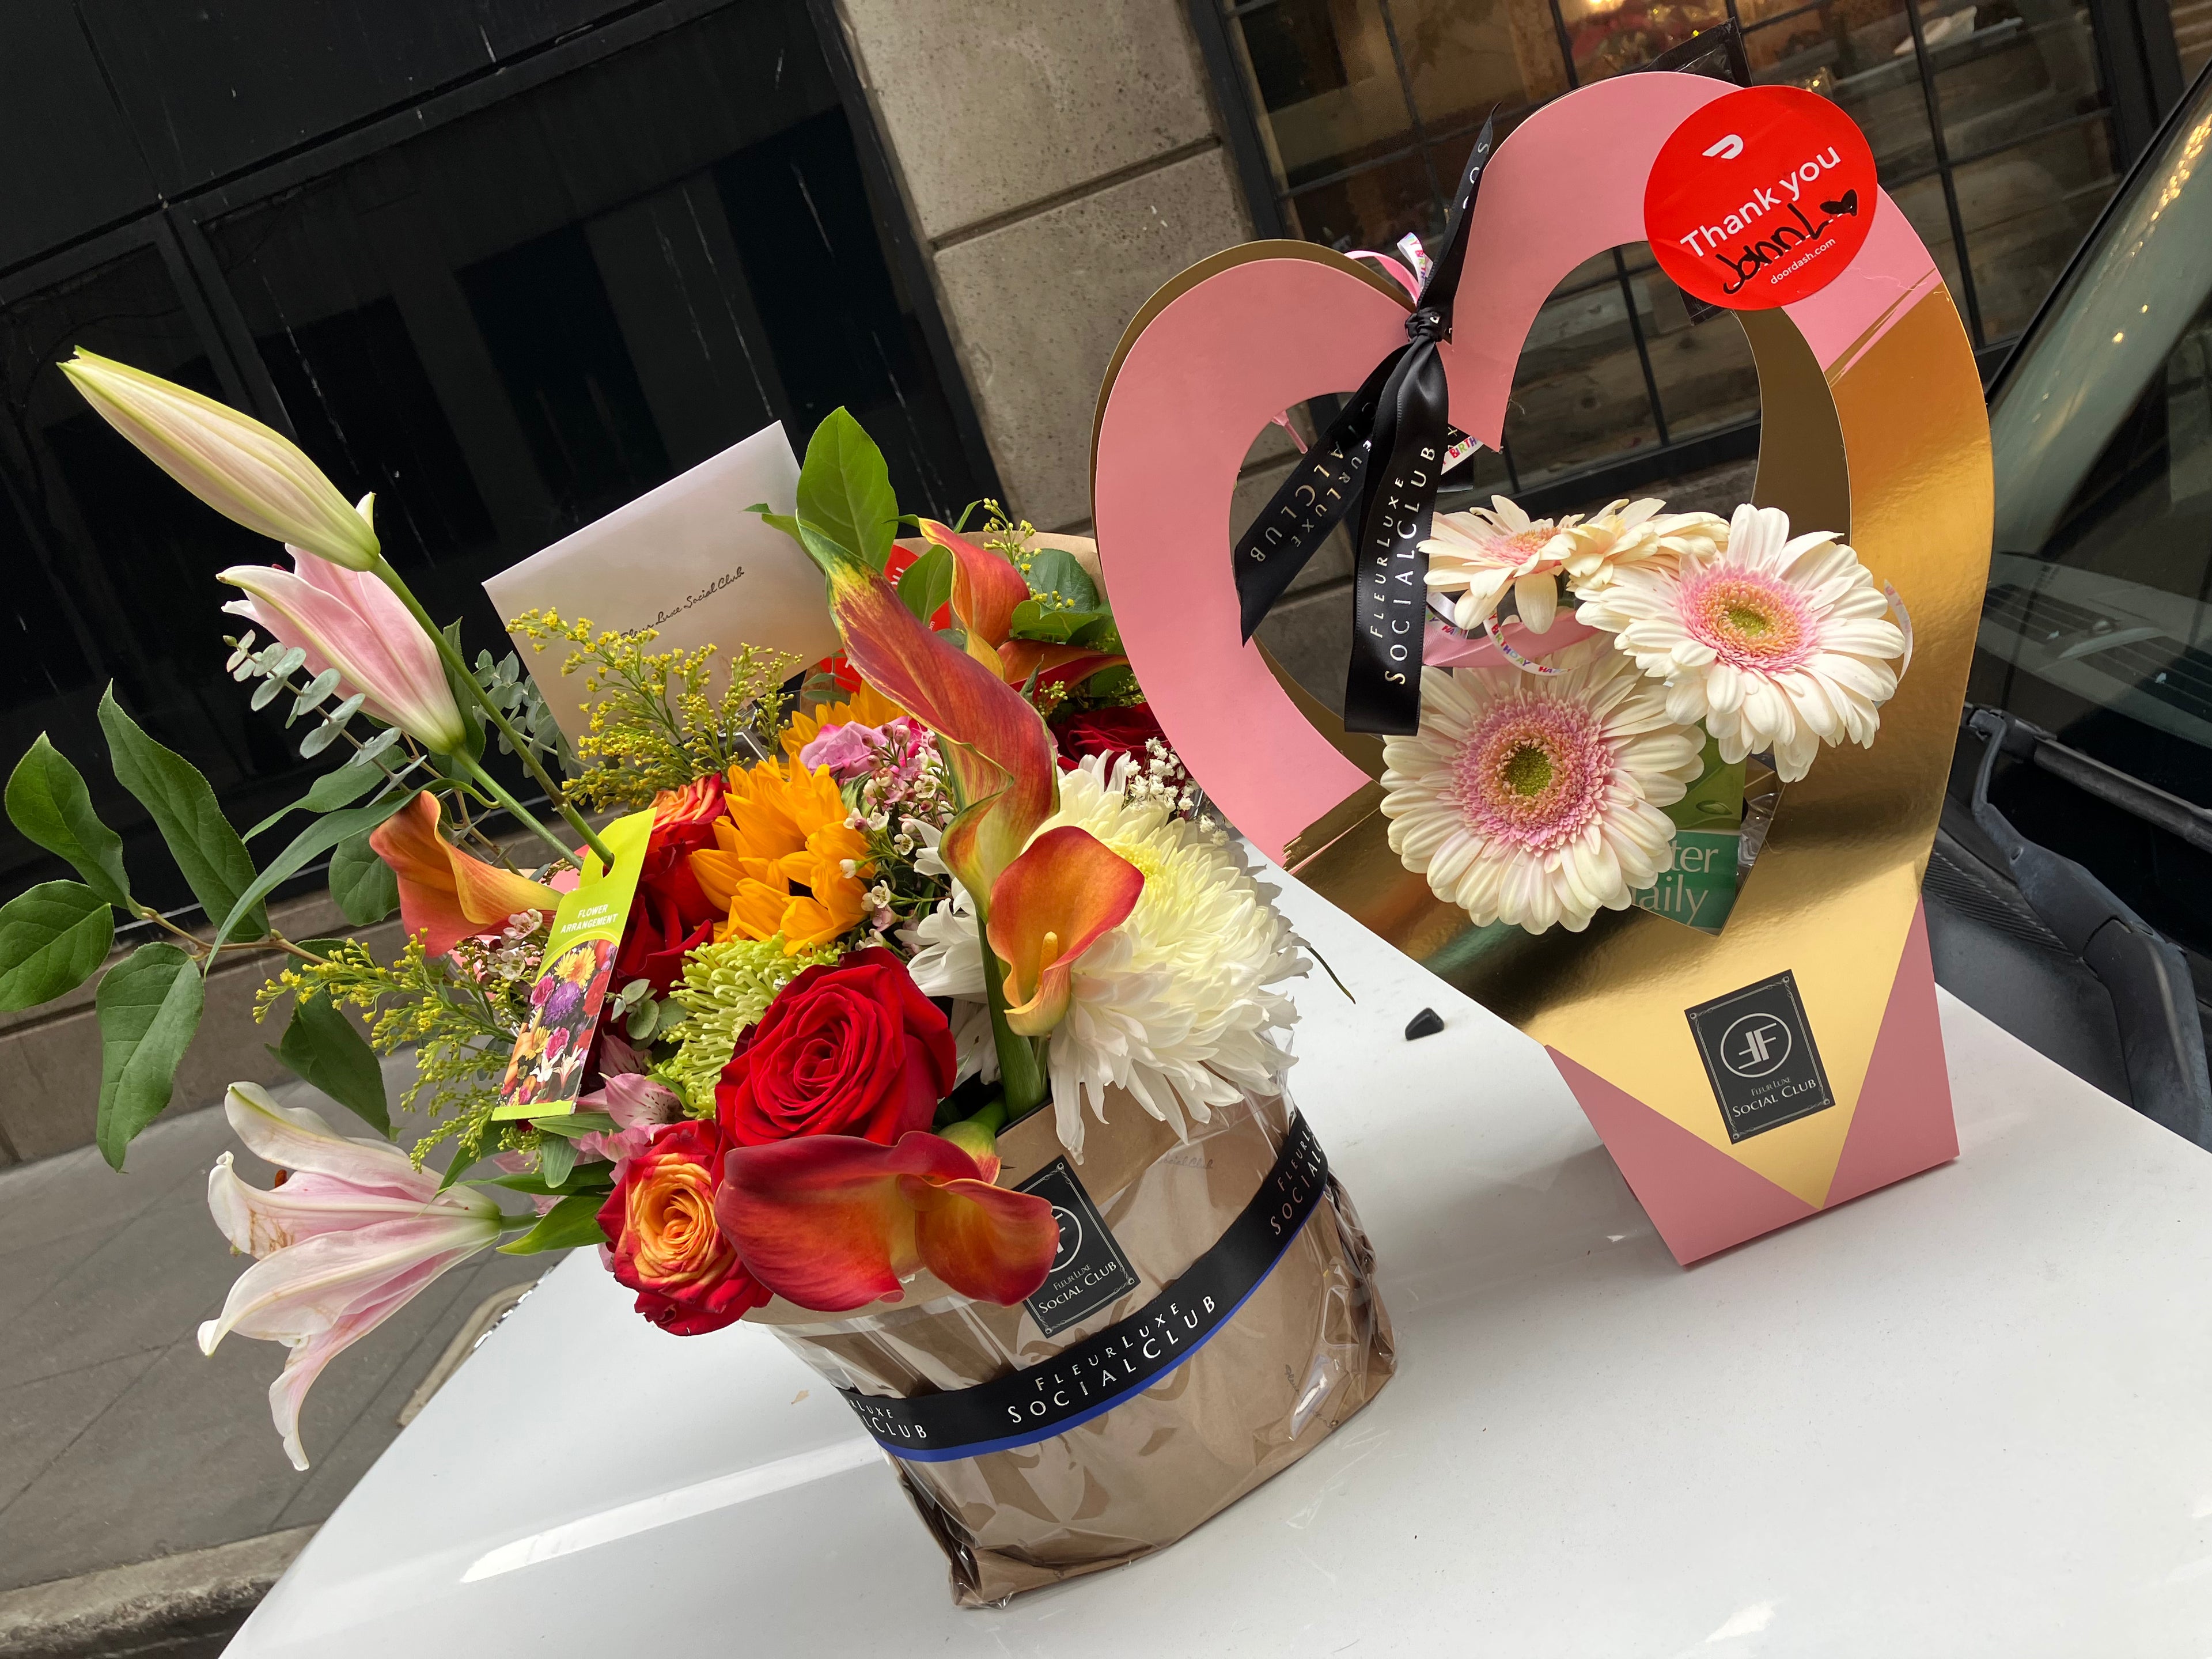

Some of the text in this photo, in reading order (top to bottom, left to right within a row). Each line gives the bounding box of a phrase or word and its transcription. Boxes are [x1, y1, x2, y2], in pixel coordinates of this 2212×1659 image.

[1679, 146, 1842, 257] Thank you
[1770, 237, 1836, 285] doordash.com
[683, 582, 718, 608] Social
[718, 566, 745, 589] Club
[577, 904, 608, 919] FLOWER
[1632, 874, 1709, 926] aily
[560, 913, 619, 934] ARRANGEMENT
[1084, 1261, 1117, 1286] CLUB
